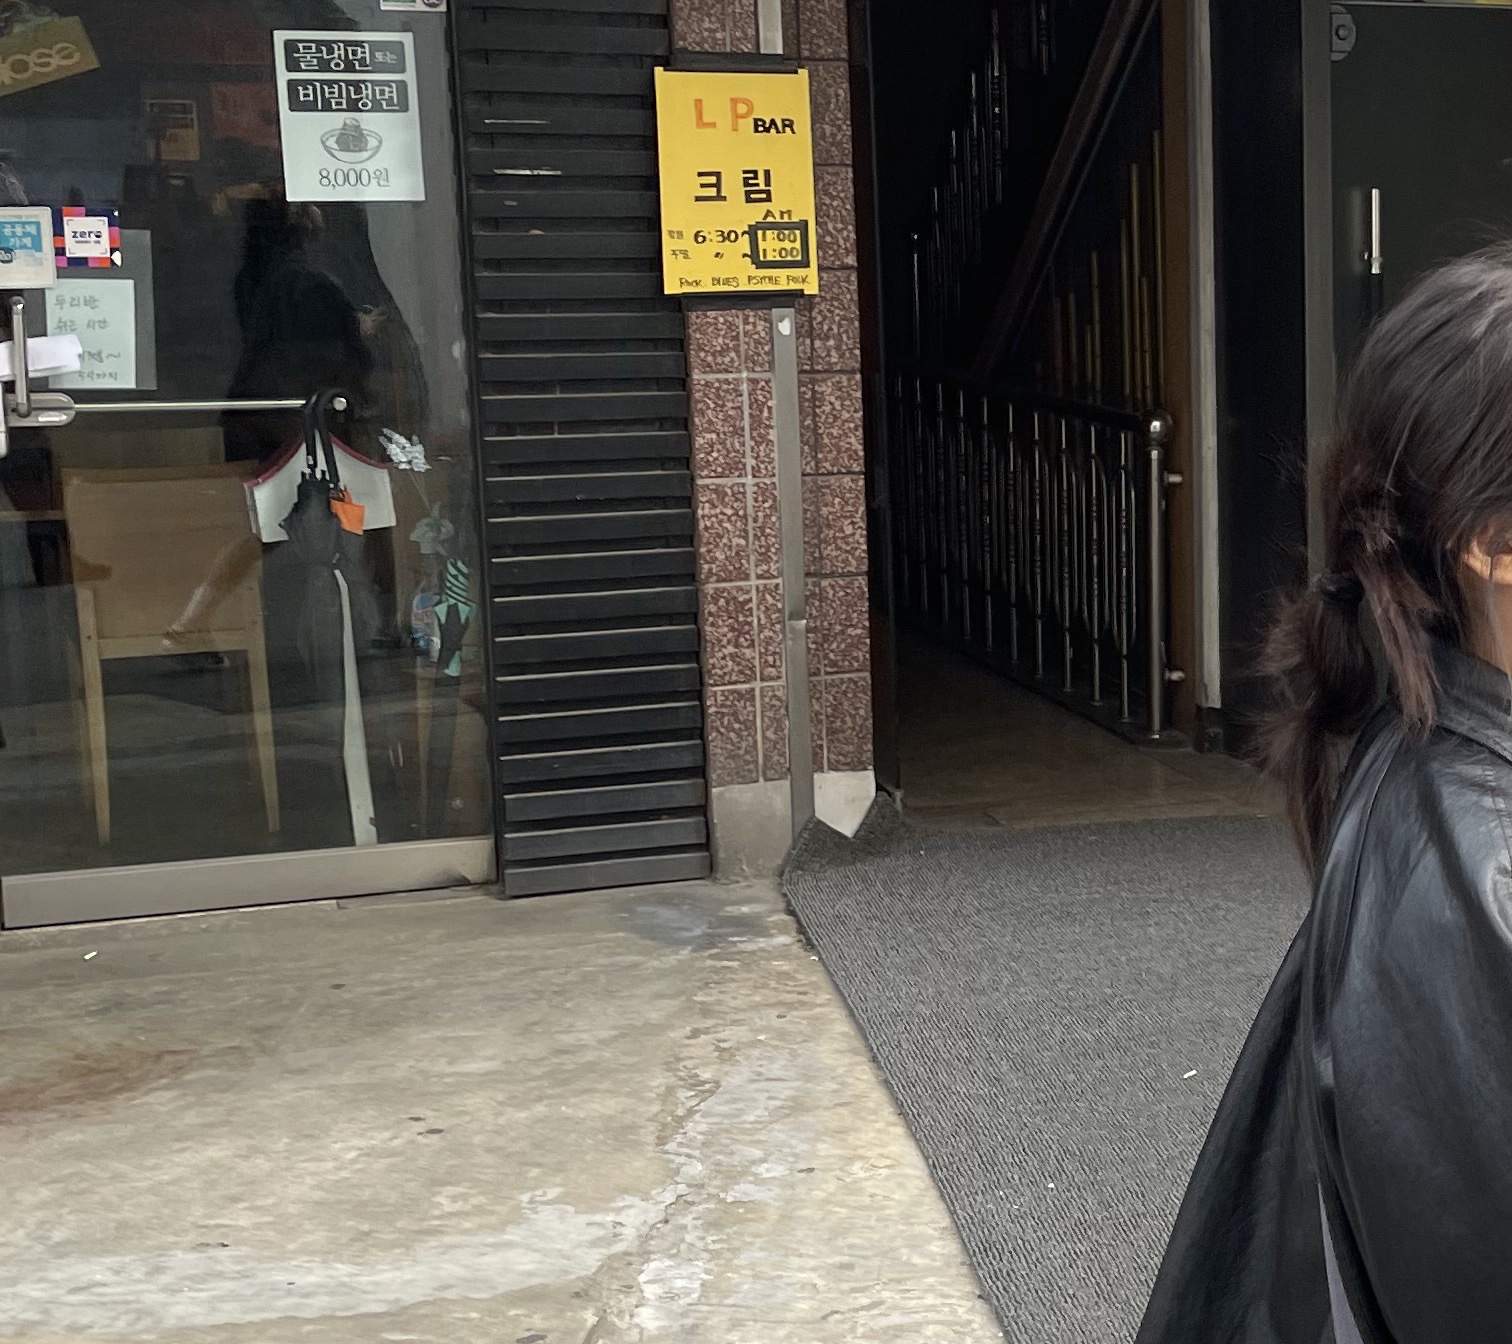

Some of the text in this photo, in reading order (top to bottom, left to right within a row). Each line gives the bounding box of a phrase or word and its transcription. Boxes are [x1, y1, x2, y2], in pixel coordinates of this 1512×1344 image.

[293, 42, 373, 71] 물냉면
[297, 81, 400, 111] 비빔냉면
[752, 117, 797, 135] BAR
[318, 167, 391, 190] 8,000원
[693, 169, 774, 204] 크림
[762, 208, 793, 221] AM
